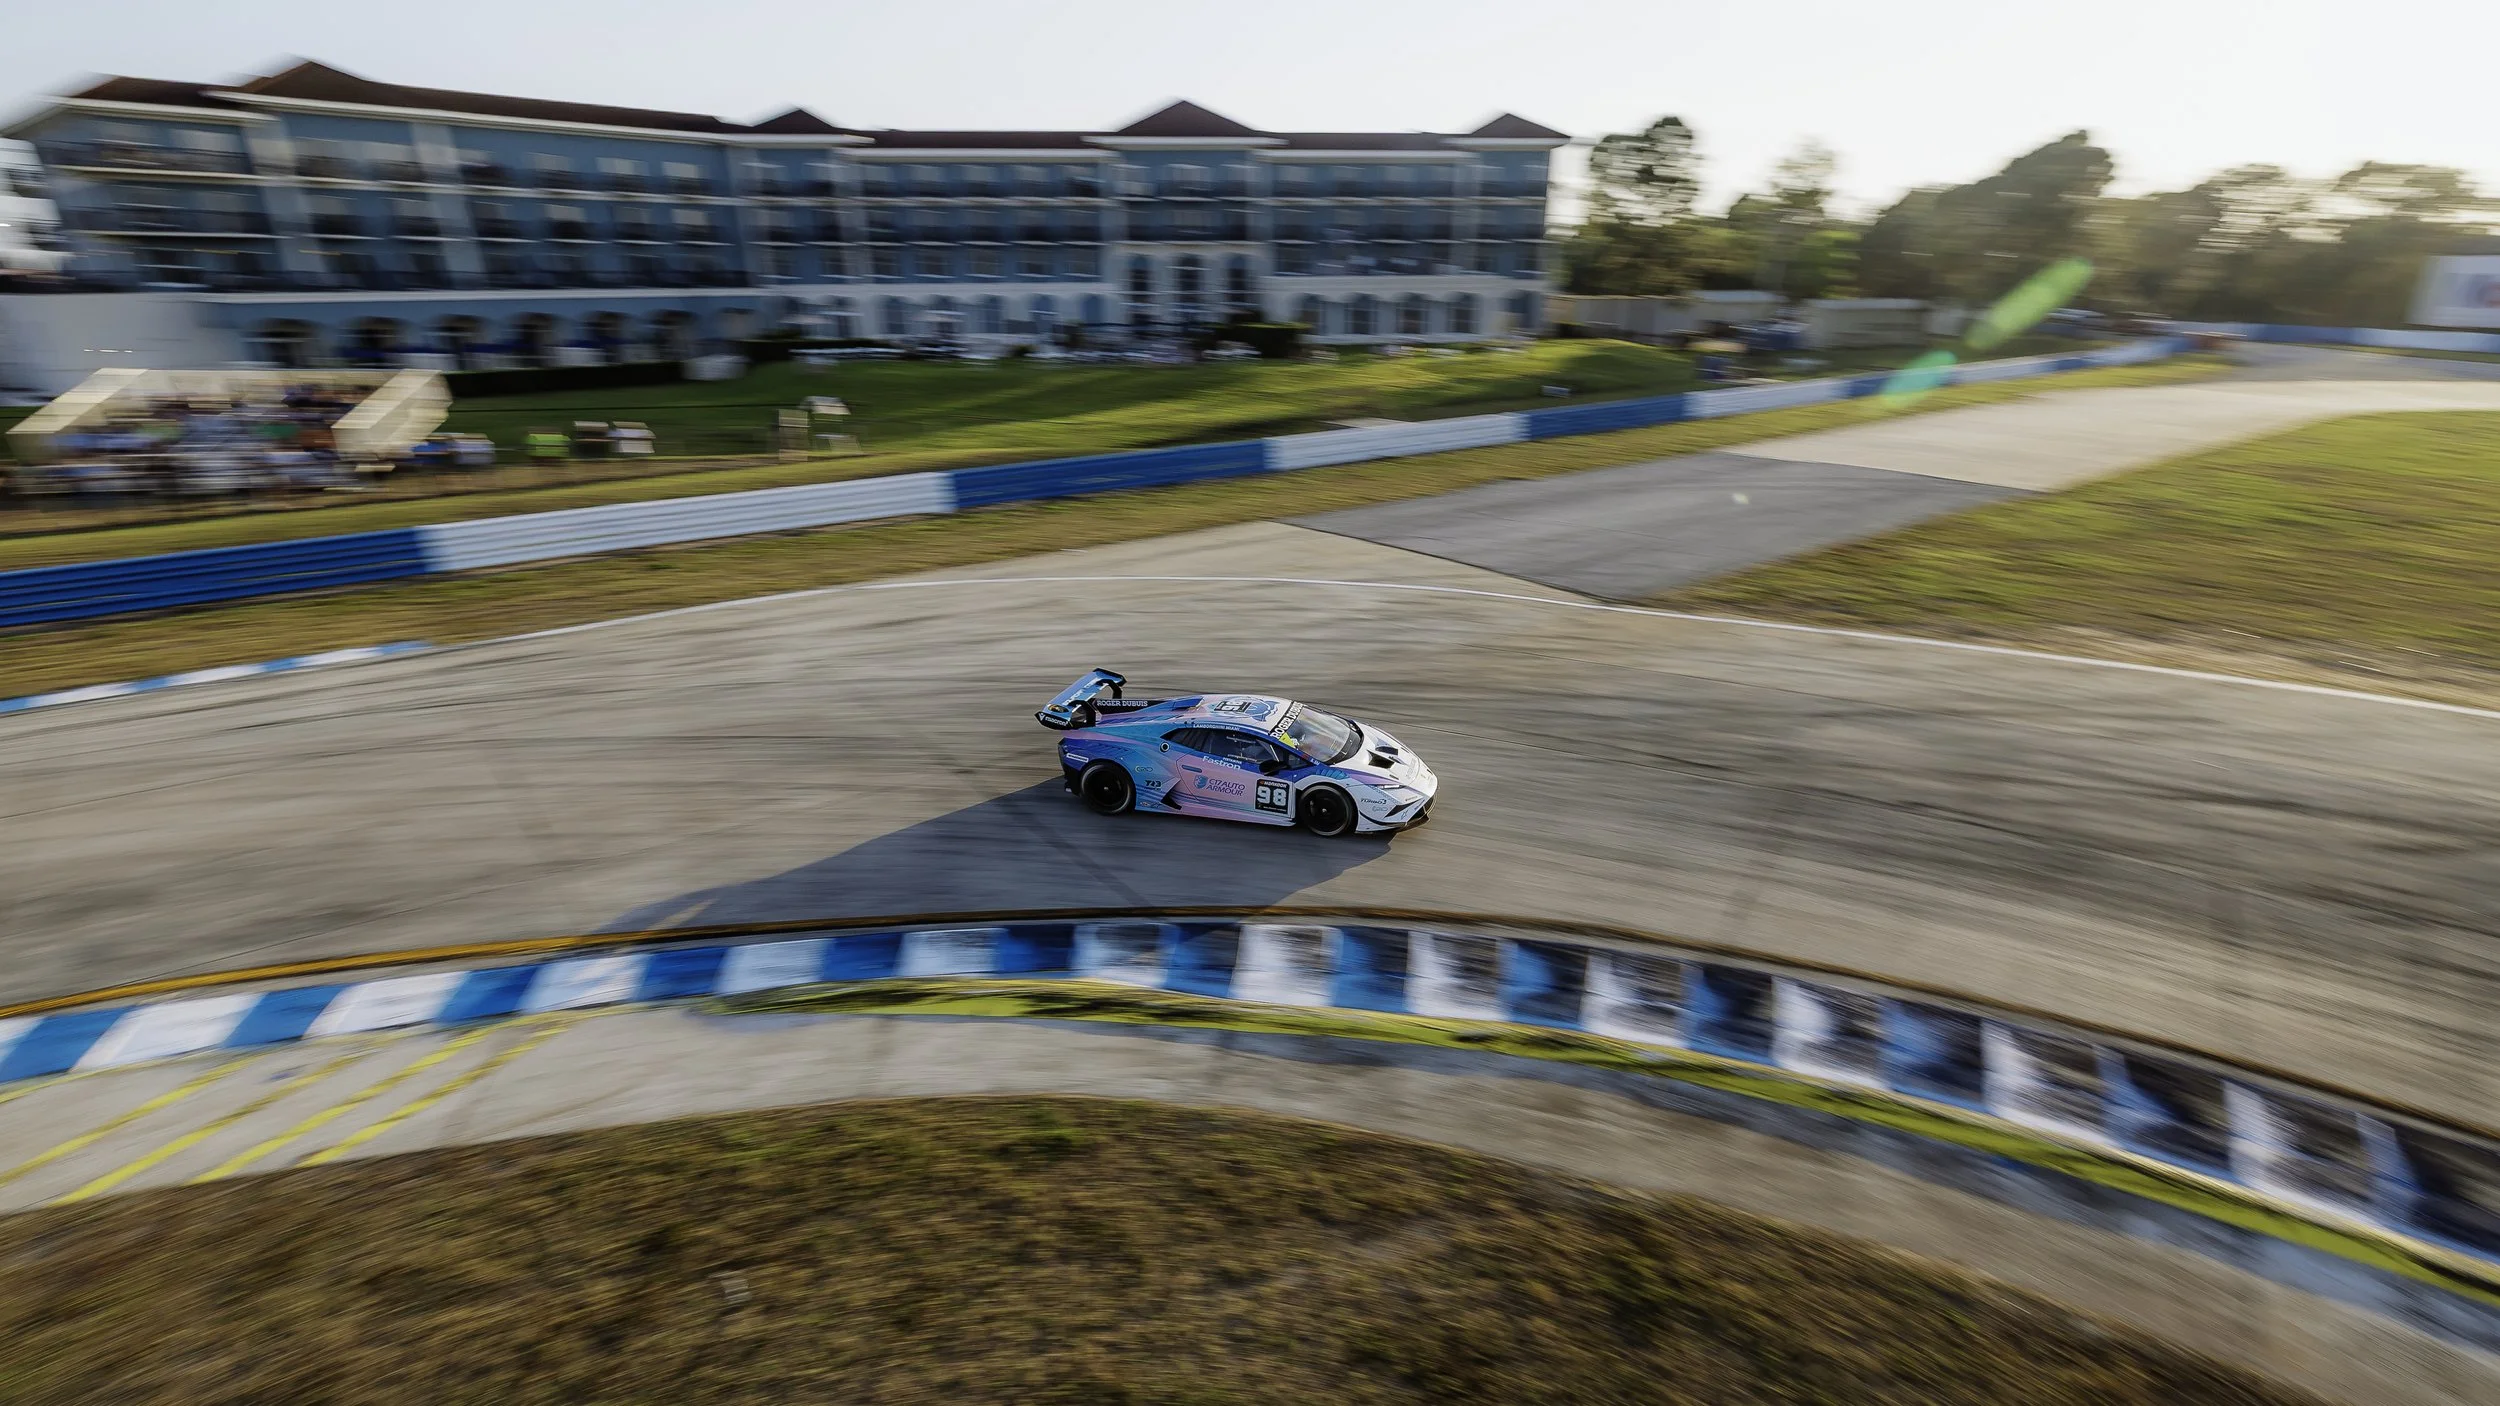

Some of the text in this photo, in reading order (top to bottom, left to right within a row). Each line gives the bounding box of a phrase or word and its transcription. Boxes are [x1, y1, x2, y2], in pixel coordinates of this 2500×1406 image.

[1270, 717, 1293, 739] ROGER
[1202, 755, 1241, 770] Fastron
[1206, 784, 1244, 797] ARMOUR
[1257, 786, 1287, 807] 98
